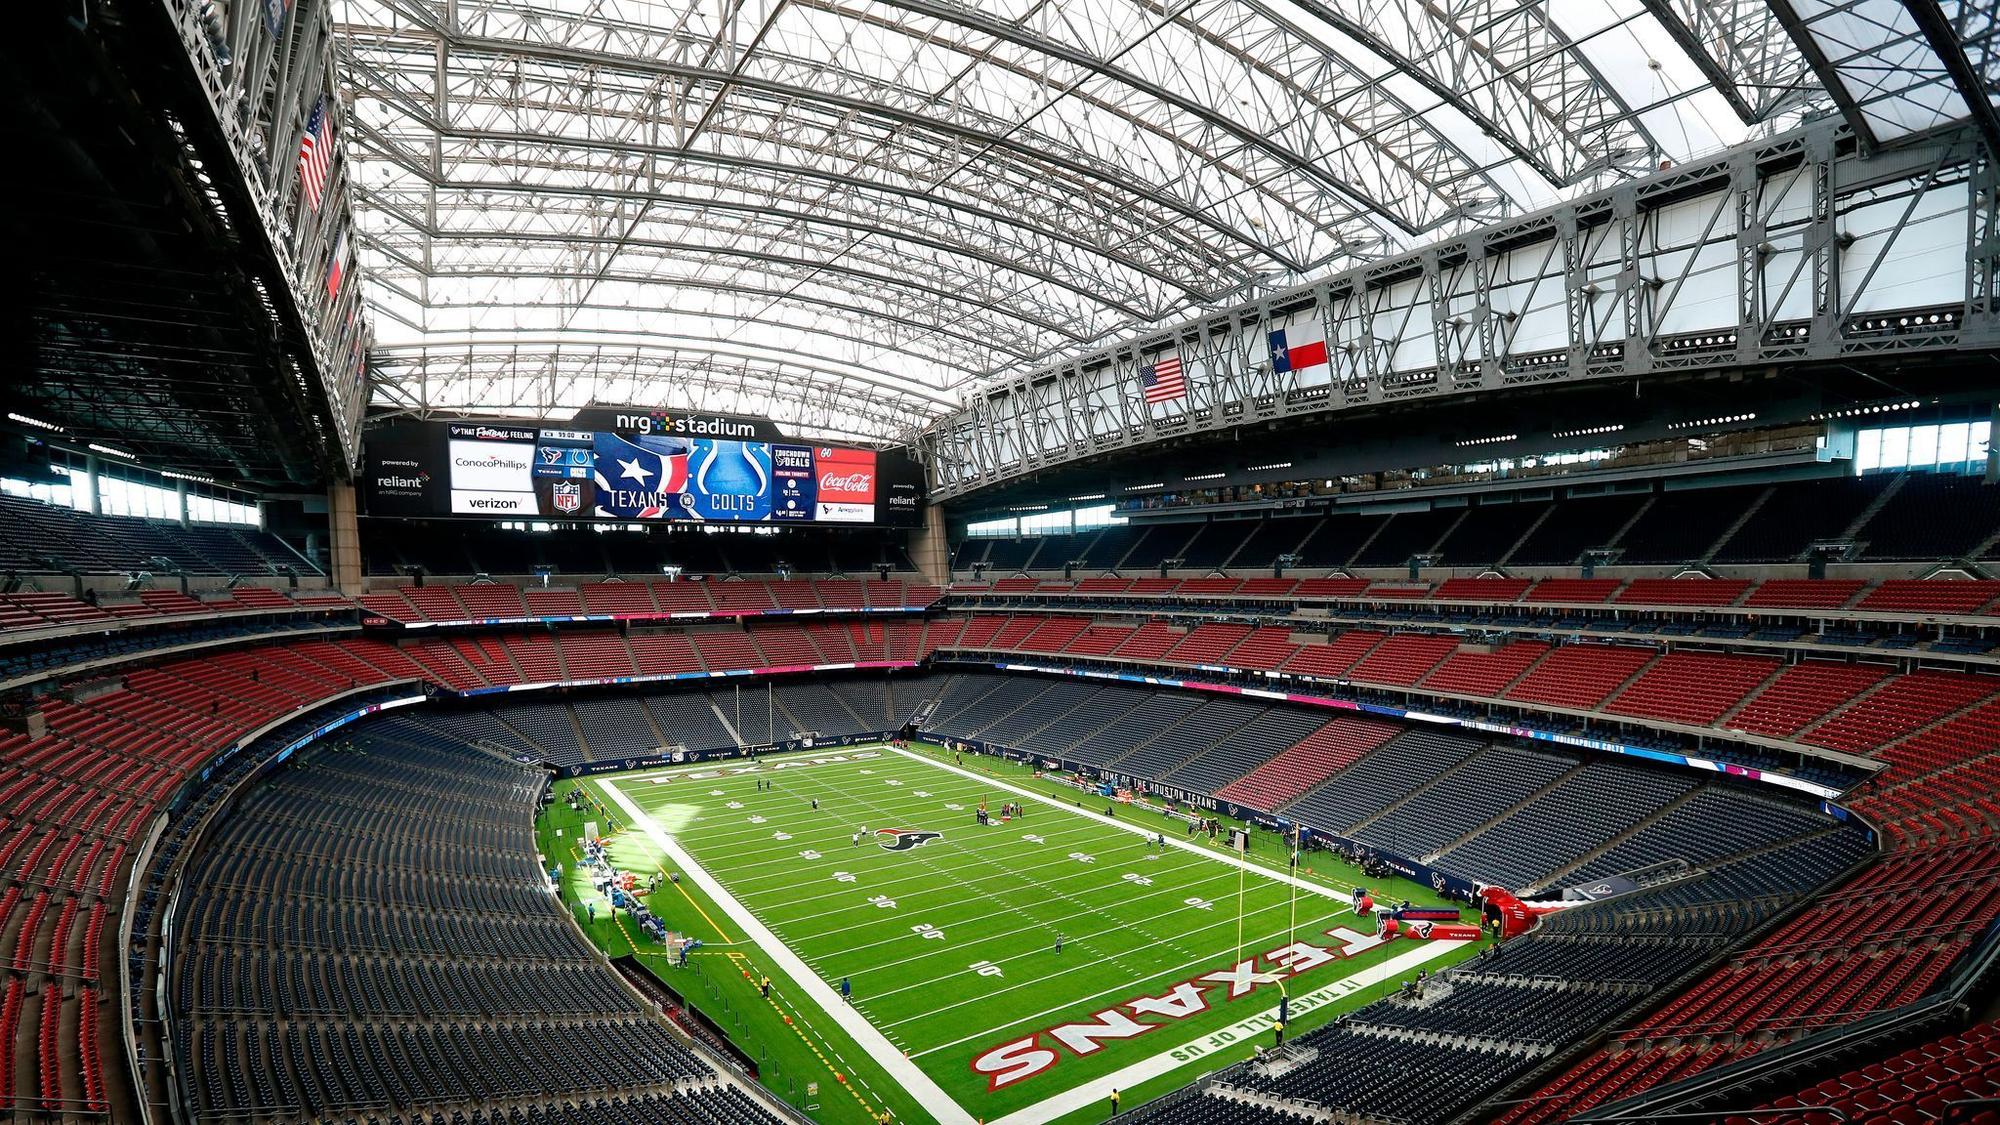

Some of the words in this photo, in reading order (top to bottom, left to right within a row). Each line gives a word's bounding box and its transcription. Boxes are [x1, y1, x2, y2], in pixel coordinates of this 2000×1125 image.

[461, 428, 475, 436] THAT
[510, 431, 534, 439] FEELING
[616, 414, 651, 434] nrg
[675, 416, 755, 437] stadium
[775, 450, 810, 458] TOUCHDOWN
[785, 458, 810, 467] DEALS
[455, 457, 527, 470] ConocoPhillips
[377, 475, 422, 488] reliant
[820, 472, 872, 493] Coca-Cola
[469, 497, 518, 509] verizon
[556, 495, 577, 508] NFL
[610, 490, 668, 508] TEXANS
[711, 493, 754, 511] COLTS
[889, 495, 915, 506] reliant
[1552, 734, 1601, 749] INDIANAPOLIS
[1601, 742, 1625, 754] COLTS
[591, 764, 618, 772] TEXANS
[1099, 769, 1118, 782] HOME
[1133, 777, 1147, 789] THE
[1149, 782, 1184, 801] HOUSTON
[1187, 792, 1217, 811] TEXANS
[1384, 860, 1416, 876] TEXANS
[910, 923, 946, 940] 20
[968, 960, 1004, 978] 10
[1338, 979, 1363, 992] IT
[969, 925, 1393, 1093] TEXANS
[1286, 989, 1341, 1017] TAKES
[1236, 1013, 1279, 1032] ALL
[1208, 1031, 1238, 1048] OF
[1170, 1045, 1205, 1062] US
